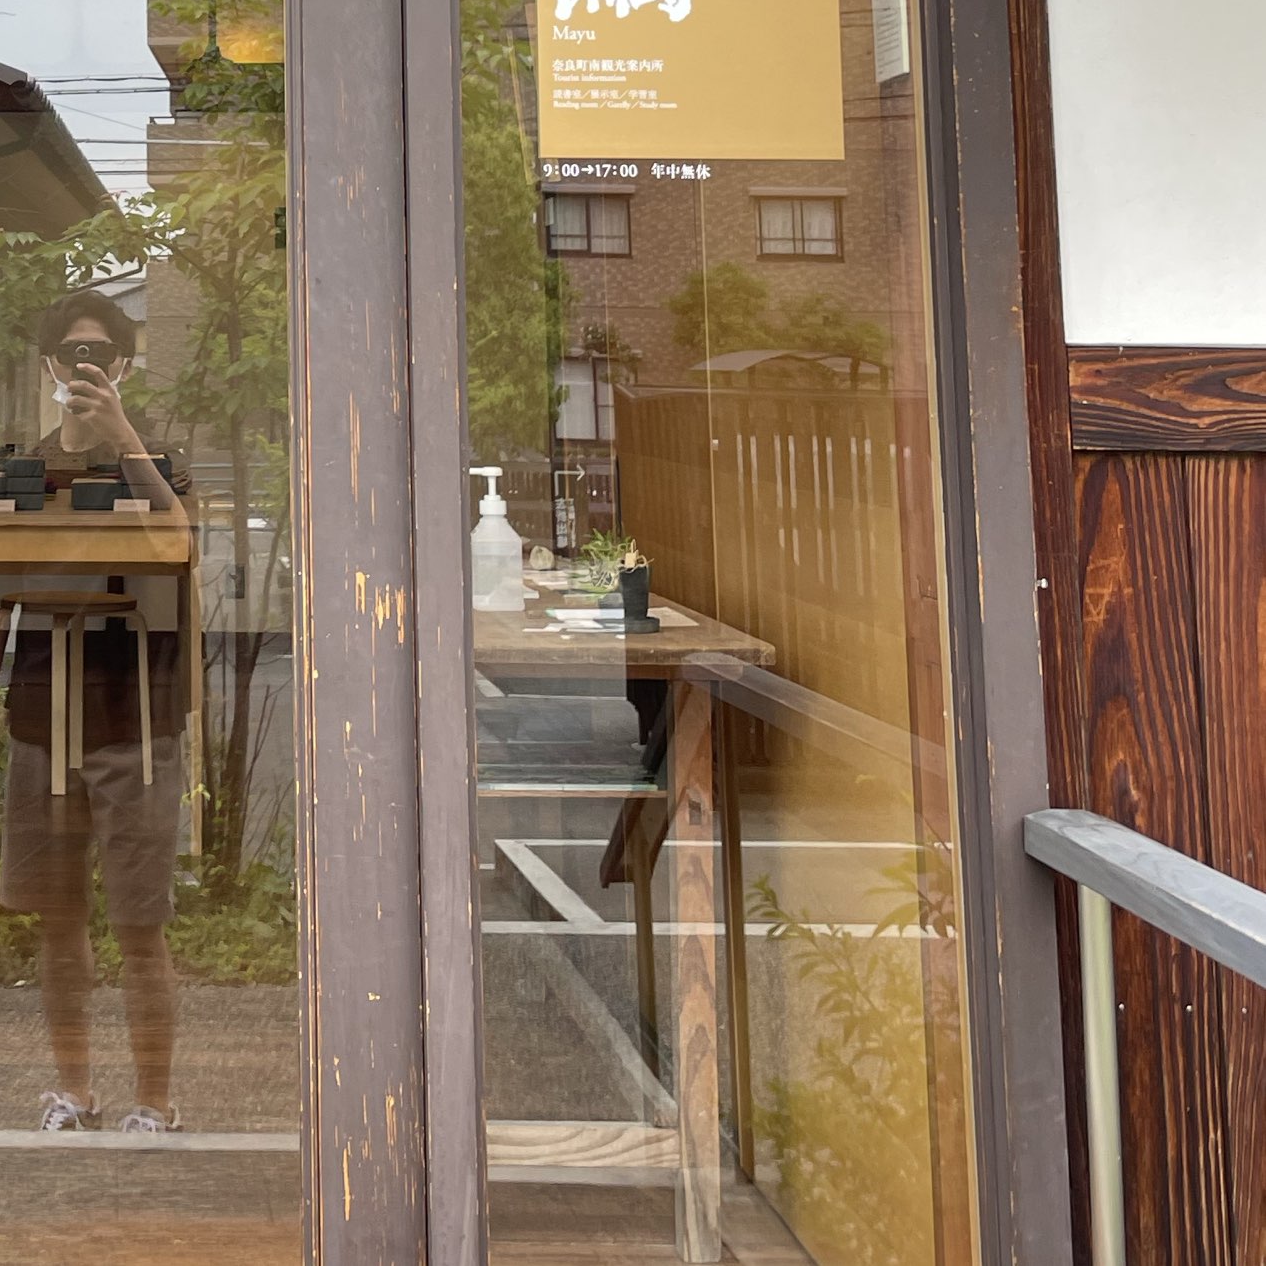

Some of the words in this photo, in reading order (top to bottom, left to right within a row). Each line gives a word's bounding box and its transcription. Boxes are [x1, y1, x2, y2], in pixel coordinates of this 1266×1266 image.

[553, 25, 596, 44] Mayu
[552, 59, 663, 72] 奈良町南観光案内所
[651, 163, 711, 179] 年中無休
